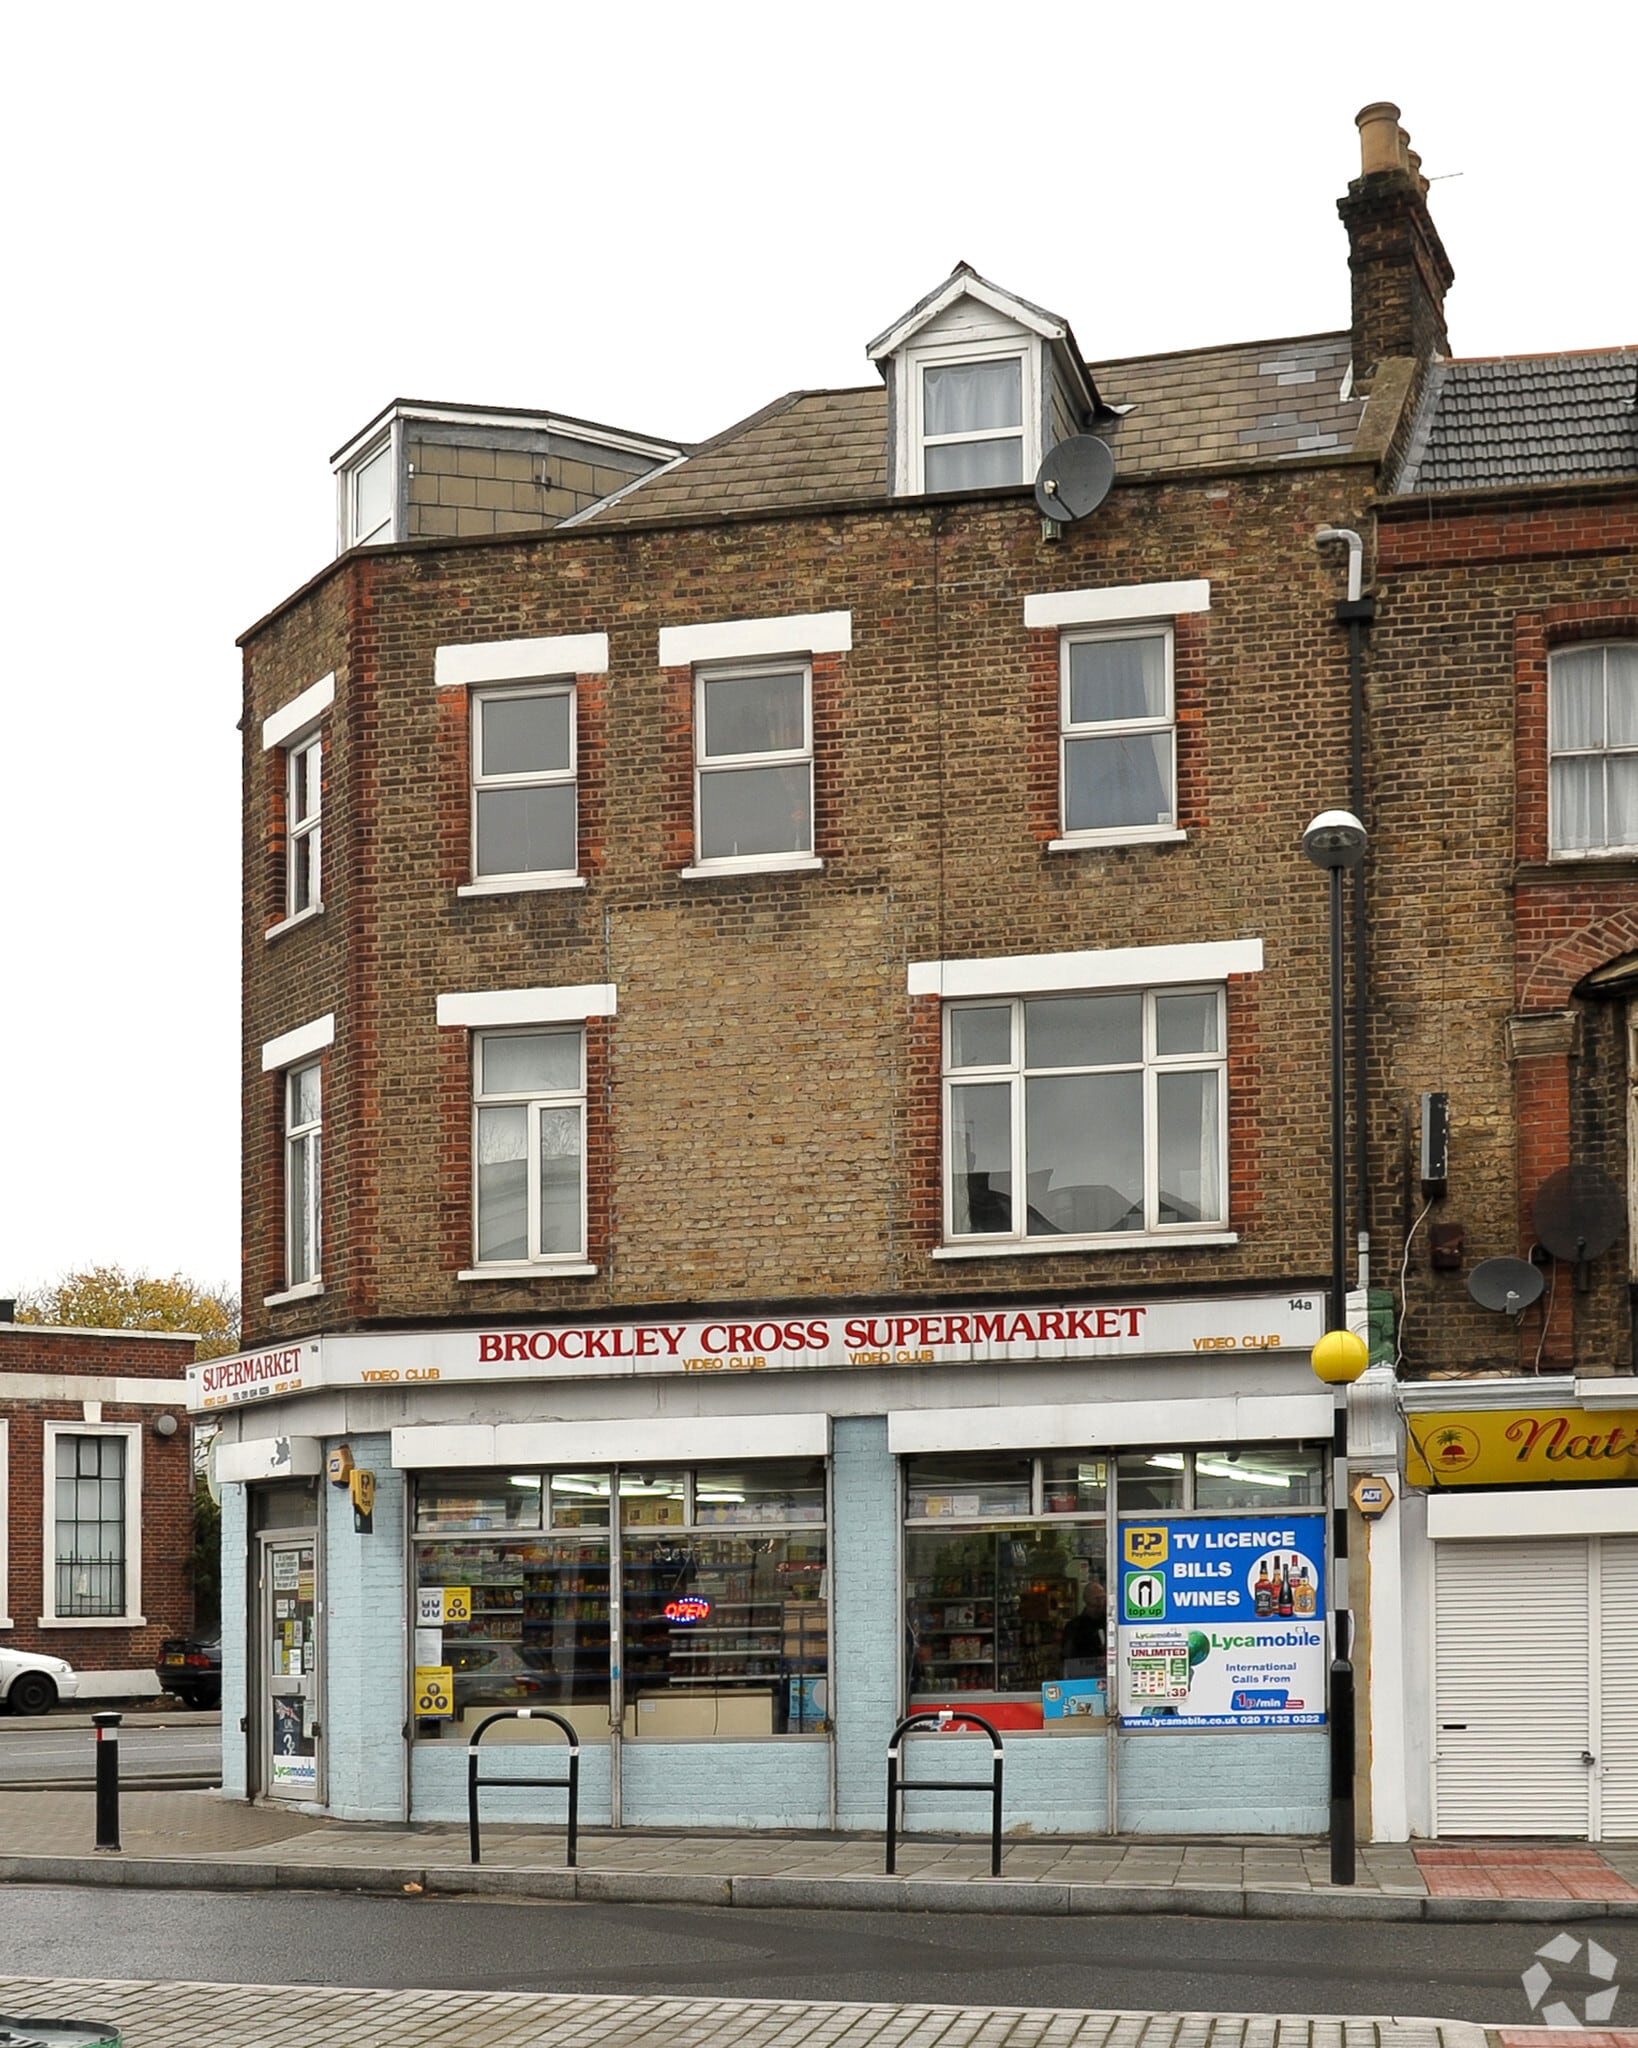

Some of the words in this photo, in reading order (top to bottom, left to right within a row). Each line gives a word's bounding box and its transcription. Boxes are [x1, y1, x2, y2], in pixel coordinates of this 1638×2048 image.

[1288, 1299, 1312, 1311] 14a
[478, 1326, 686, 1363] BROCKLEY
[700, 1320, 829, 1354] CROSS
[844, 1307, 1147, 1349] SUPERMARKET
[1193, 1337, 1236, 1350] VIDEO
[1242, 1335, 1281, 1349] CLUB
[683, 1358, 724, 1370] VIDEO
[729, 1356, 766, 1369] CLUB
[849, 1352, 890, 1365] VIDEO
[896, 1350, 934, 1363] CLUB
[203, 1348, 301, 1392] SUPERMARKET
[361, 1370, 399, 1382] VIDEO
[405, 1368, 440, 1380] CLUB
[1362, 1490, 1382, 1500] ADT
[1172, 1533, 1200, 1549] TV
[1205, 1531, 1296, 1548] LICENCE
[1173, 1562, 1232, 1578] BILLS
[1172, 1590, 1241, 1607] WINES
[664, 1602, 710, 1618] OPEN
[1128, 1608, 1146, 1617] top
[1149, 1608, 1162, 1616] up
[1135, 1632, 1182, 1640] Lycamobile
[1211, 1631, 1321, 1651] Lycamobile
[1131, 1648, 1187, 1657] UNLIMITED
[1225, 1662, 1297, 1672] International
[1231, 1675, 1259, 1684] Calls
[1262, 1674, 1291, 1683] From
[1123, 1716, 1238, 1727] www.lycamobile.co.uk
[1240, 1716, 1261, 1724] 020
[1264, 1715, 1290, 1724] 7132
[1292, 1715, 1320, 1723] 0322
